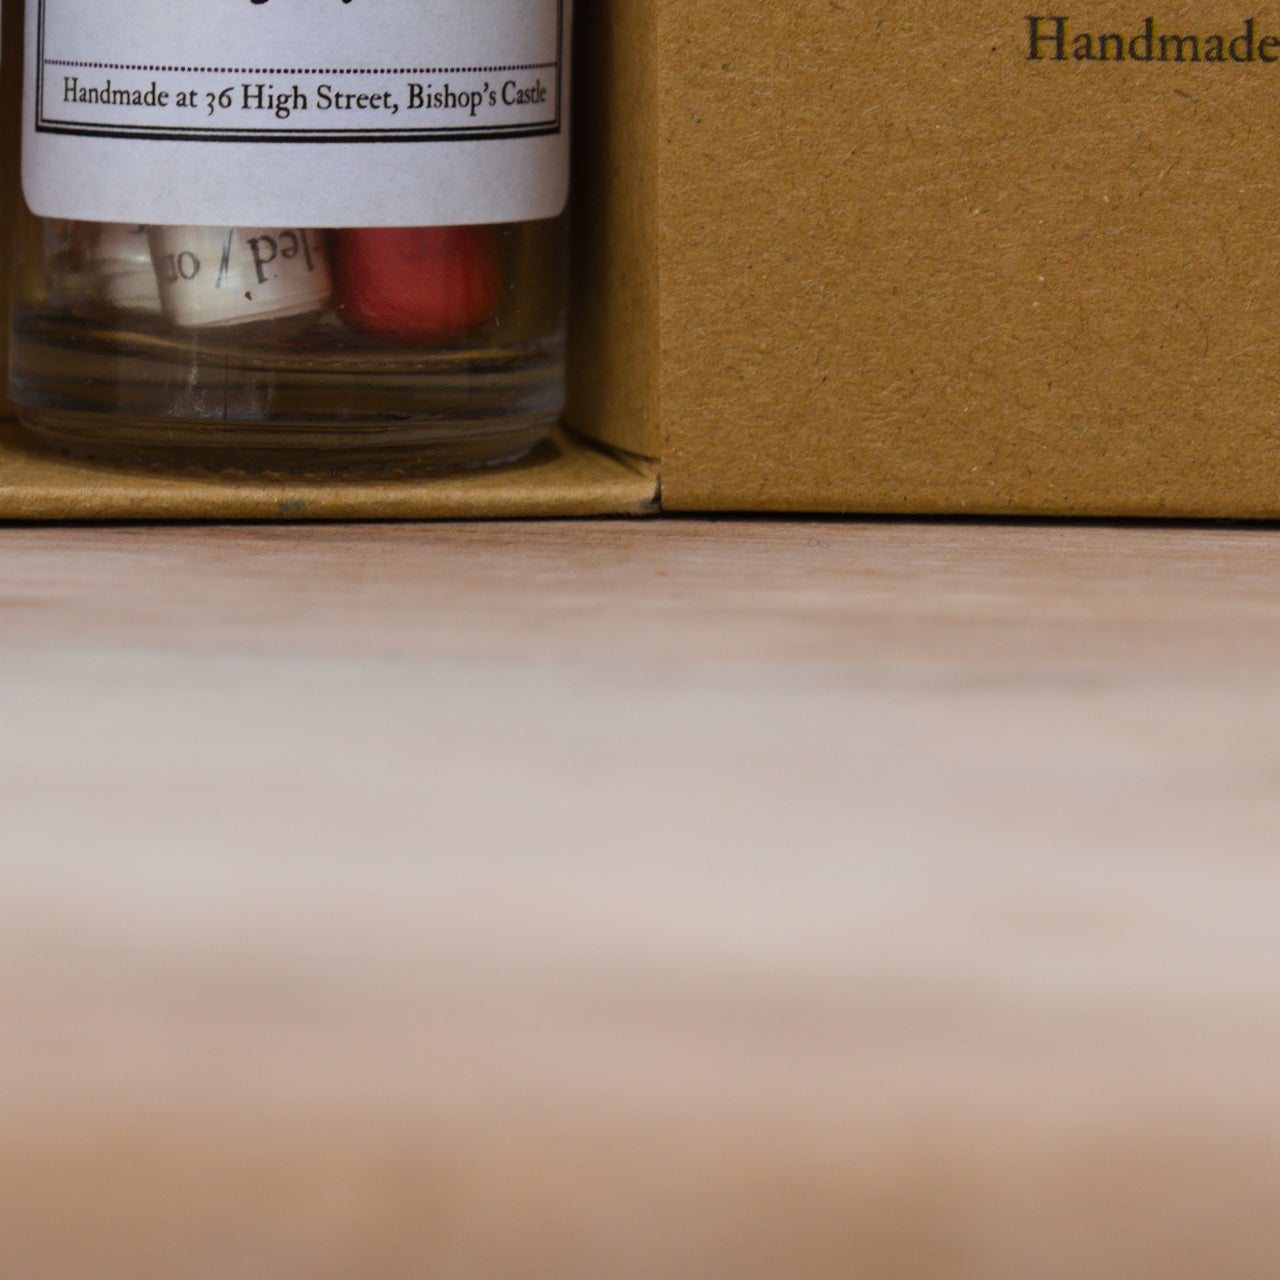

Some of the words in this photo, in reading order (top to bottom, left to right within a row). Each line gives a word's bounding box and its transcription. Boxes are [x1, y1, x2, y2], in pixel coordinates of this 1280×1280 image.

[63, 76, 170, 108] Handmade
[175, 89, 198, 108] at
[205, 86, 234, 116] 36
[241, 83, 308, 120] High
[316, 84, 399, 115] Street,
[407, 81, 497, 117] Bishop's
[501, 78, 549, 106] Castle
